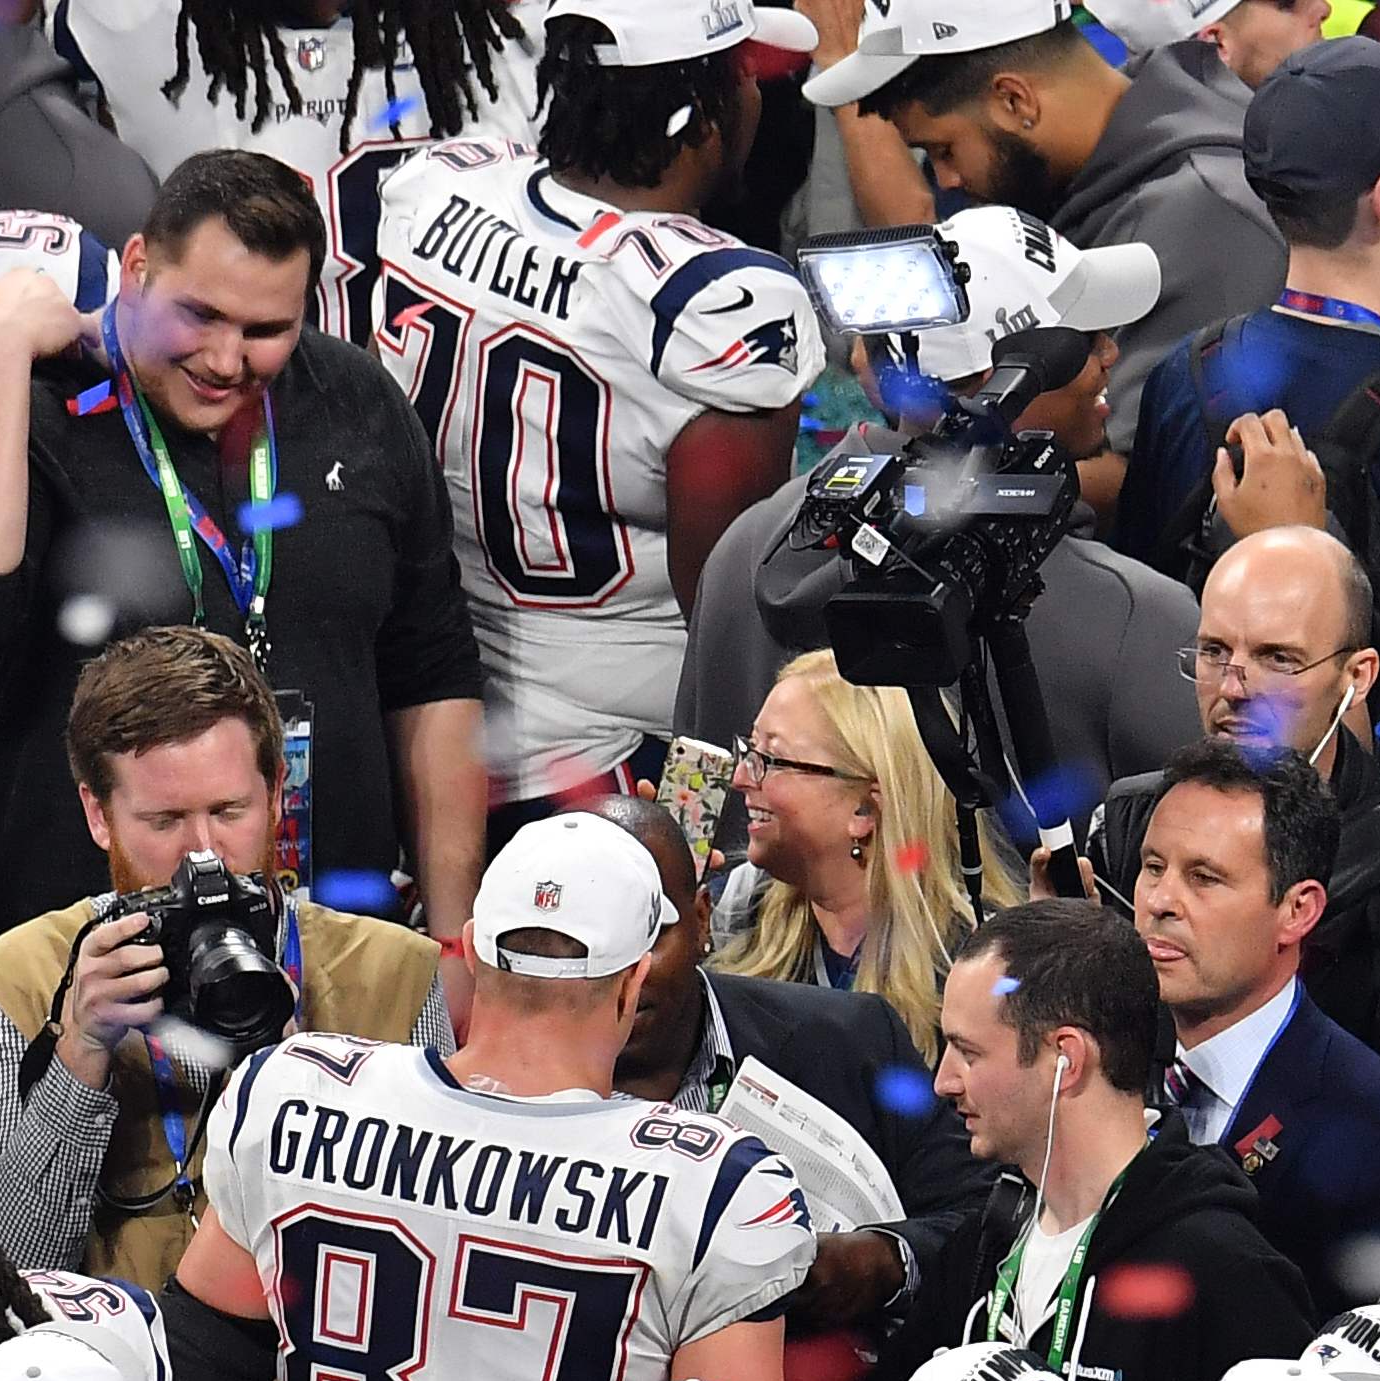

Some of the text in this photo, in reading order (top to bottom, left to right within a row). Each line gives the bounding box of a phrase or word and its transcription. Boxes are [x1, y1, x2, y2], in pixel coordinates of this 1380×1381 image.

[411, 195, 583, 320] BUTLER
[376, 260, 637, 609] 70
[1034, 445, 1054, 469] SONY
[197, 893, 229, 905] Canon
[270, 1099, 670, 1251] GRONKOWSKI
